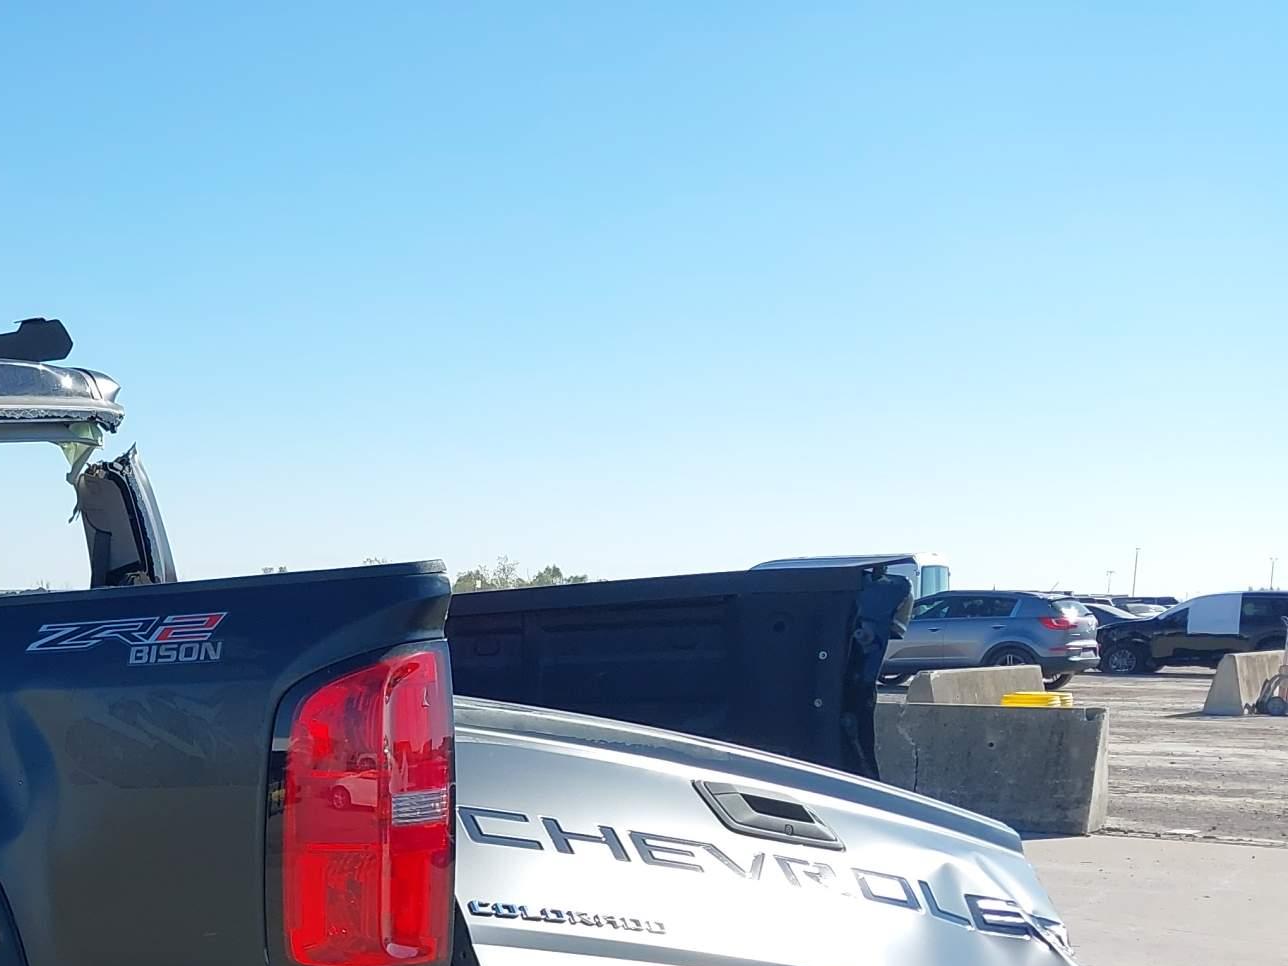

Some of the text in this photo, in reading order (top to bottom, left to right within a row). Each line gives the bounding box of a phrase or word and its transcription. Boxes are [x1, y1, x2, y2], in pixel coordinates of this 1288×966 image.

[26, 611, 228, 651] ZR2
[128, 641, 223, 665] BISON
[467, 899, 667, 935] COLORADO
